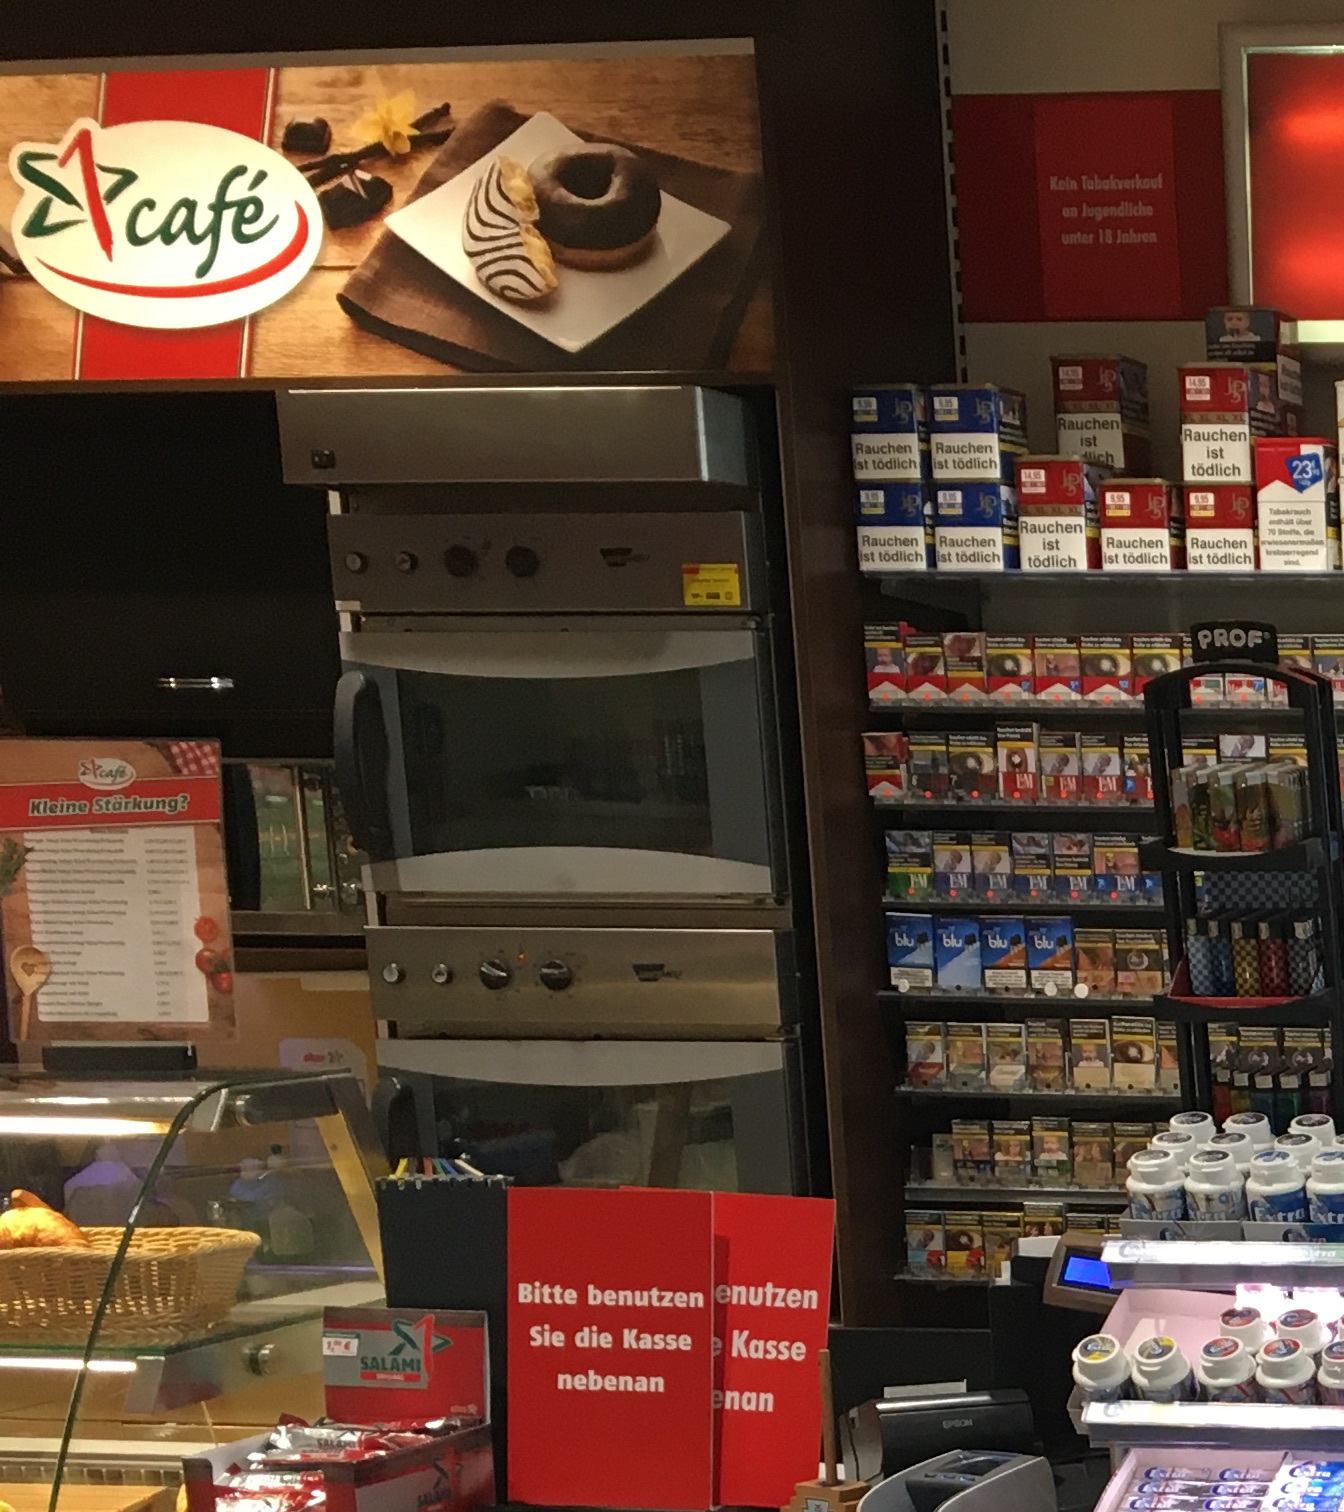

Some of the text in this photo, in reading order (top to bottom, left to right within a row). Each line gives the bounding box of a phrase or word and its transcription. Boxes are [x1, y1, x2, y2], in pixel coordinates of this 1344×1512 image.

[1049, 172, 1164, 193] Kein Tabakverkauf
[125, 165, 279, 278] café
[1061, 202, 1154, 223] an Jugendliche
[1061, 227, 1158, 246] unter 18 Jahren
[1183, 427, 1247, 445] Rauchen
[1206, 445, 1223, 460] ist
[1190, 461, 1241, 478] tödlich
[1198, 629, 1263, 650] PROF
[29, 795, 189, 816] Kleine Stärkung?
[518, 1281, 704, 1308] Bitte benutzen
[715, 1283, 818, 1309] enutzen
[530, 1324, 692, 1350] Sie die Kasse
[731, 1330, 806, 1361] Kasse
[360, 1357, 421, 1372] SALAMI
[557, 1370, 665, 1392] nebenan
